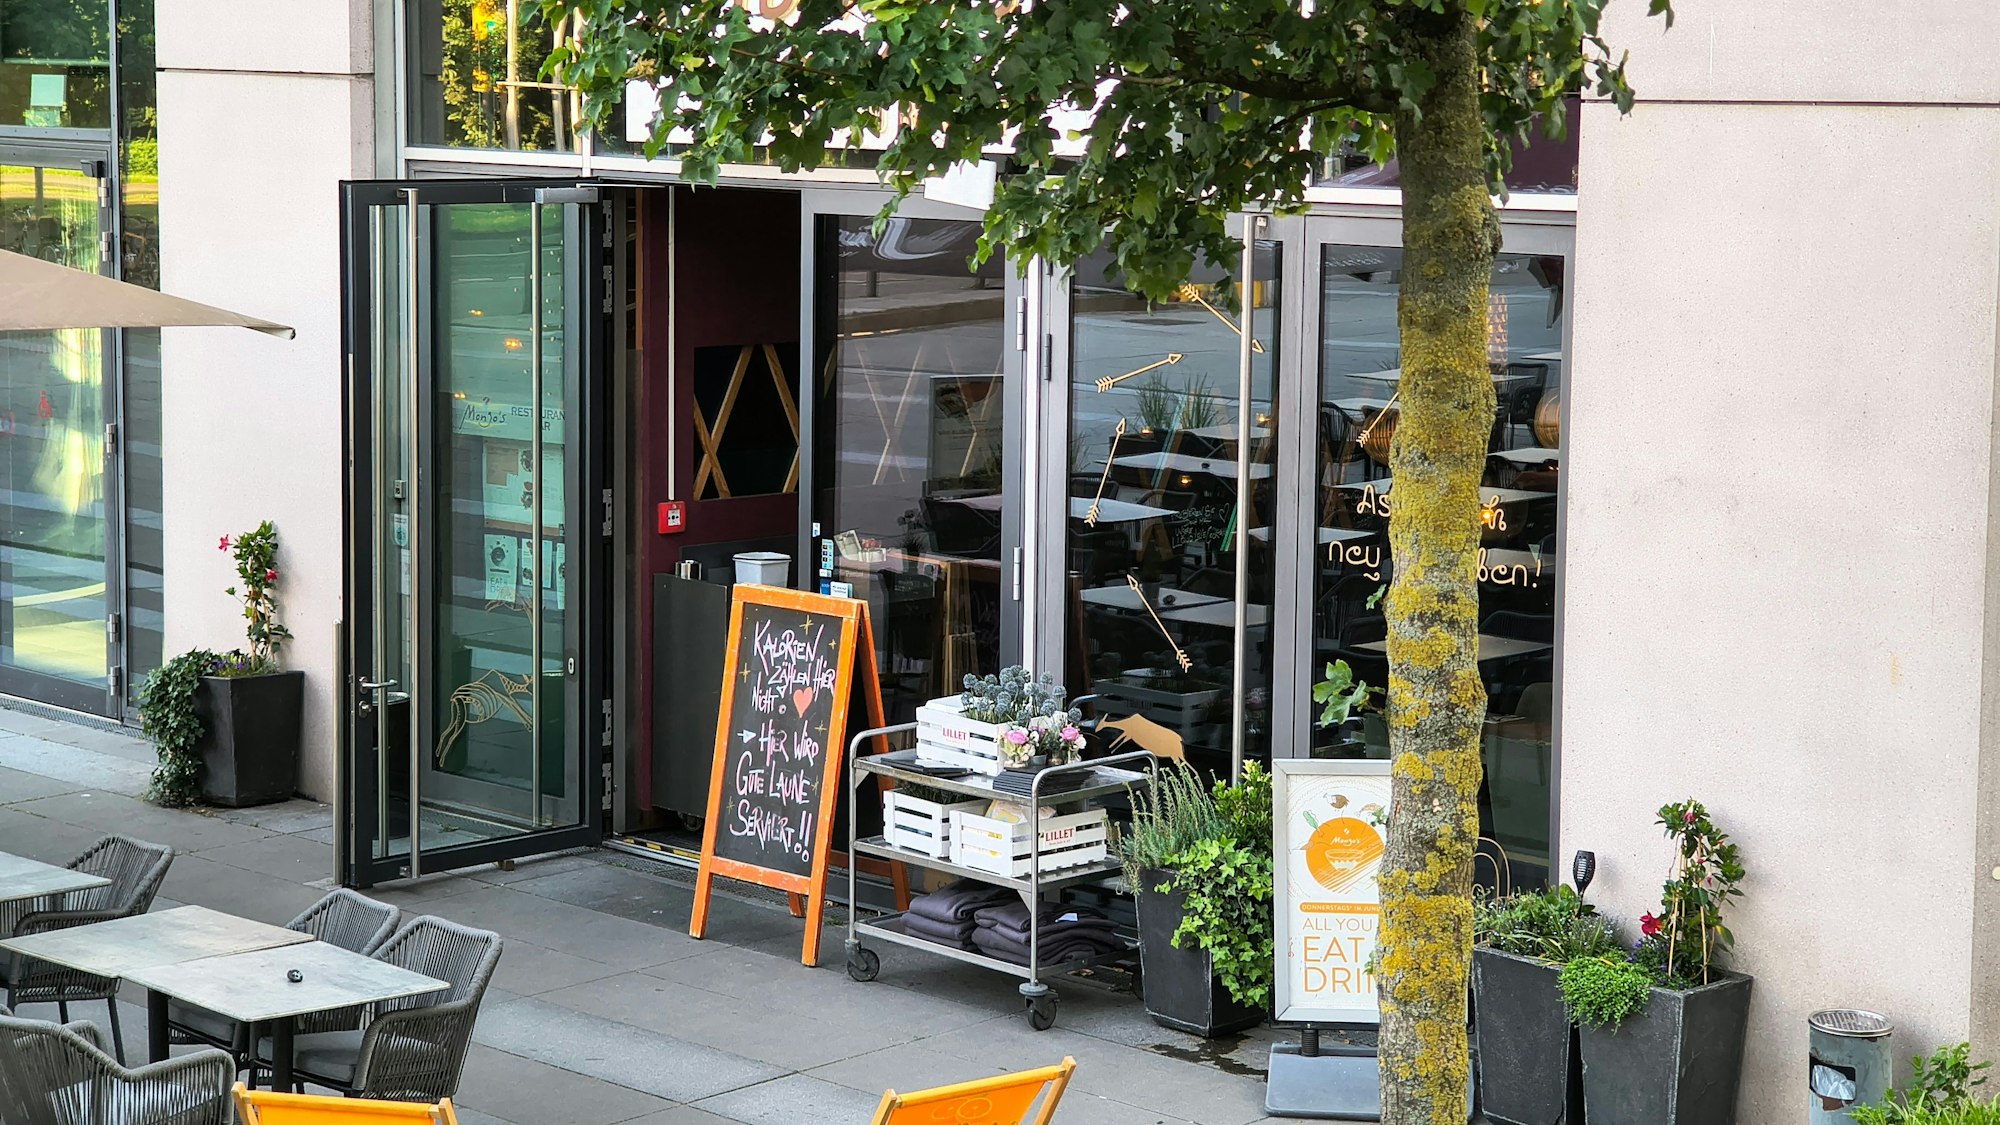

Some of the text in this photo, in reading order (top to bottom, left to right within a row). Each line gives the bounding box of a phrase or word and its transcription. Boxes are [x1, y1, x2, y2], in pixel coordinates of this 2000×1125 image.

[943, 728, 967, 741] LILLET
[736, 750, 811, 806] GUTE LAUNE
[1045, 827, 1075, 842] LILLET
[1302, 917, 1373, 932] ALL YOU
[1304, 936, 1365, 963] EAT
